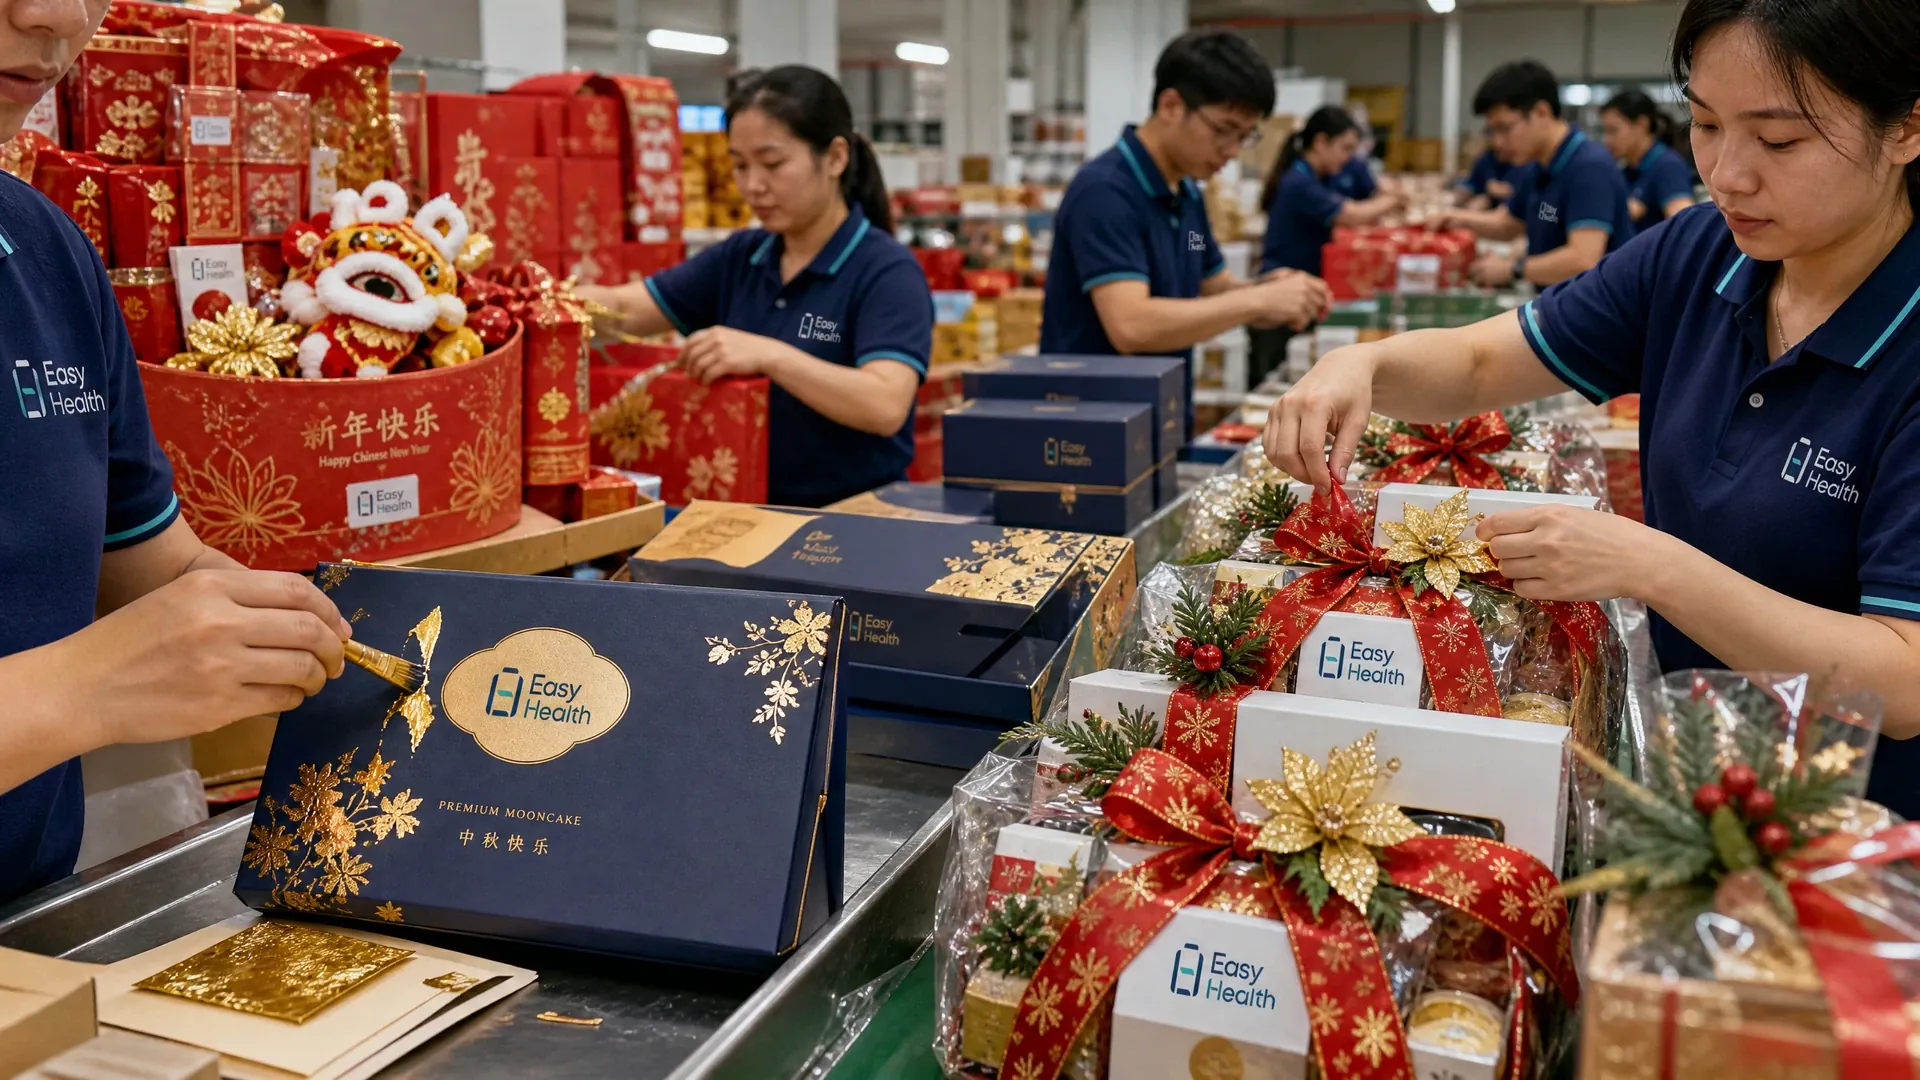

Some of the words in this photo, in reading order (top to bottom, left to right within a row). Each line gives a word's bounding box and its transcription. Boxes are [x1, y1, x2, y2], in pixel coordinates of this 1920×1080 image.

[812, 329, 841, 343] Health
[814, 316, 838, 332] Easy
[42, 360, 85, 390] Easy
[49, 389, 106, 416] Health
[300, 401, 440, 452] 新年快乐
[318, 455, 351, 468] Happy
[353, 450, 389, 464] Chinese
[389, 446, 409, 458] New
[410, 443, 431, 455] Year
[1061, 440, 1086, 456] Easy
[1813, 447, 1857, 481] Easy
[376, 490, 404, 501] Easy
[1805, 470, 1860, 504] Health
[376, 500, 412, 514] Health
[865, 614, 893, 632] Easy
[863, 630, 900, 645] Health
[1350, 641, 1395, 667] Easy
[1347, 662, 1405, 686] Health
[529, 673, 582, 703] Easy
[523, 698, 591, 725] Health
[438, 800, 499, 816] PREMIUM
[504, 808, 582, 826] MOONCAKE
[459, 828, 549, 856] 中秋快乐
[1210, 951, 1264, 986] Easy
[1205, 978, 1276, 1010] Health
